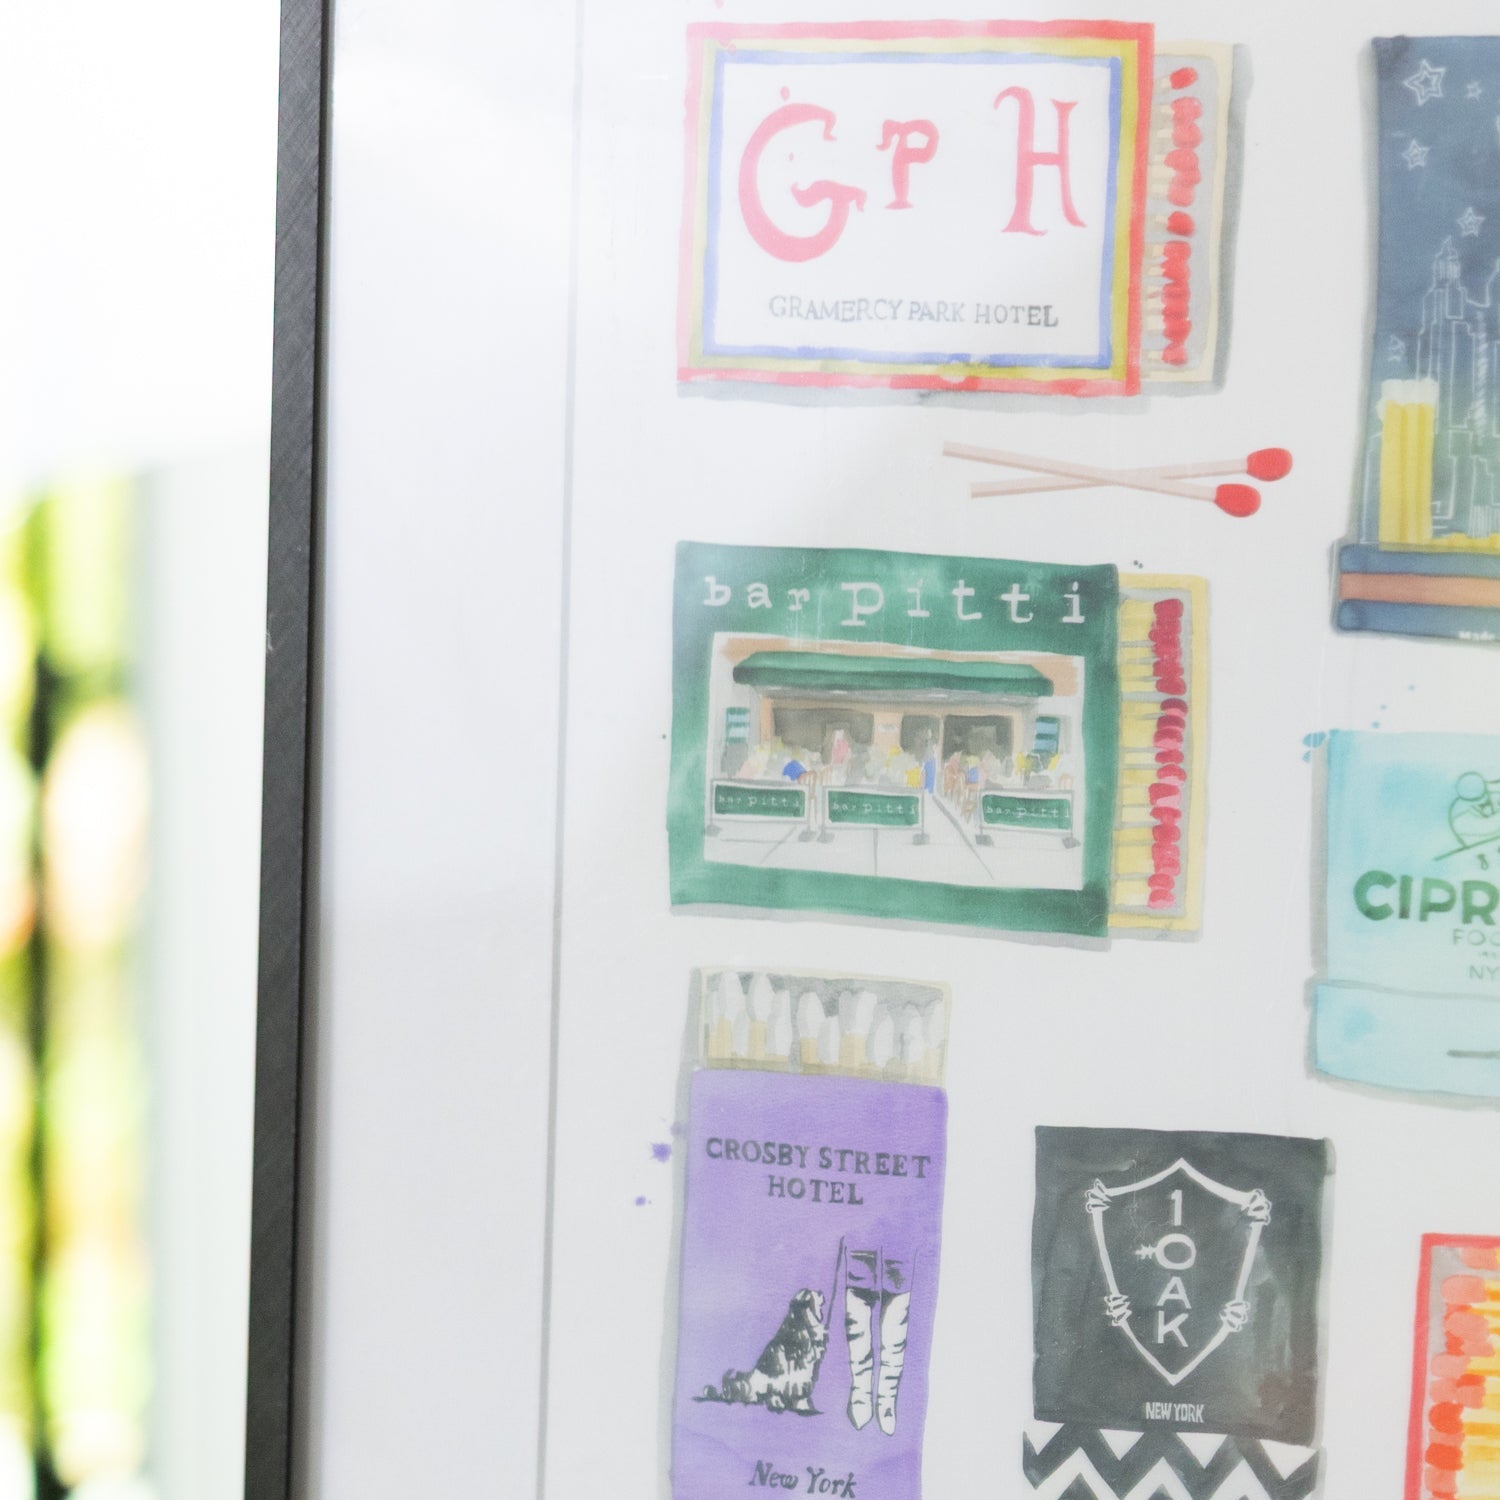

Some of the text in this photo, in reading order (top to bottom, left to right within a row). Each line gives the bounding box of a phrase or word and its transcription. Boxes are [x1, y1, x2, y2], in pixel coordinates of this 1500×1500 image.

[769, 294, 1060, 328] GRAMERCY PARK HOTEL
[703, 574, 1087, 628] bar pitti
[706, 1136, 933, 1181] CROSBY STREET
[766, 1173, 866, 1206] HOTEL
[1145, 1401, 1205, 1424] NEW YORK
[748, 1458, 858, 1500] New York
